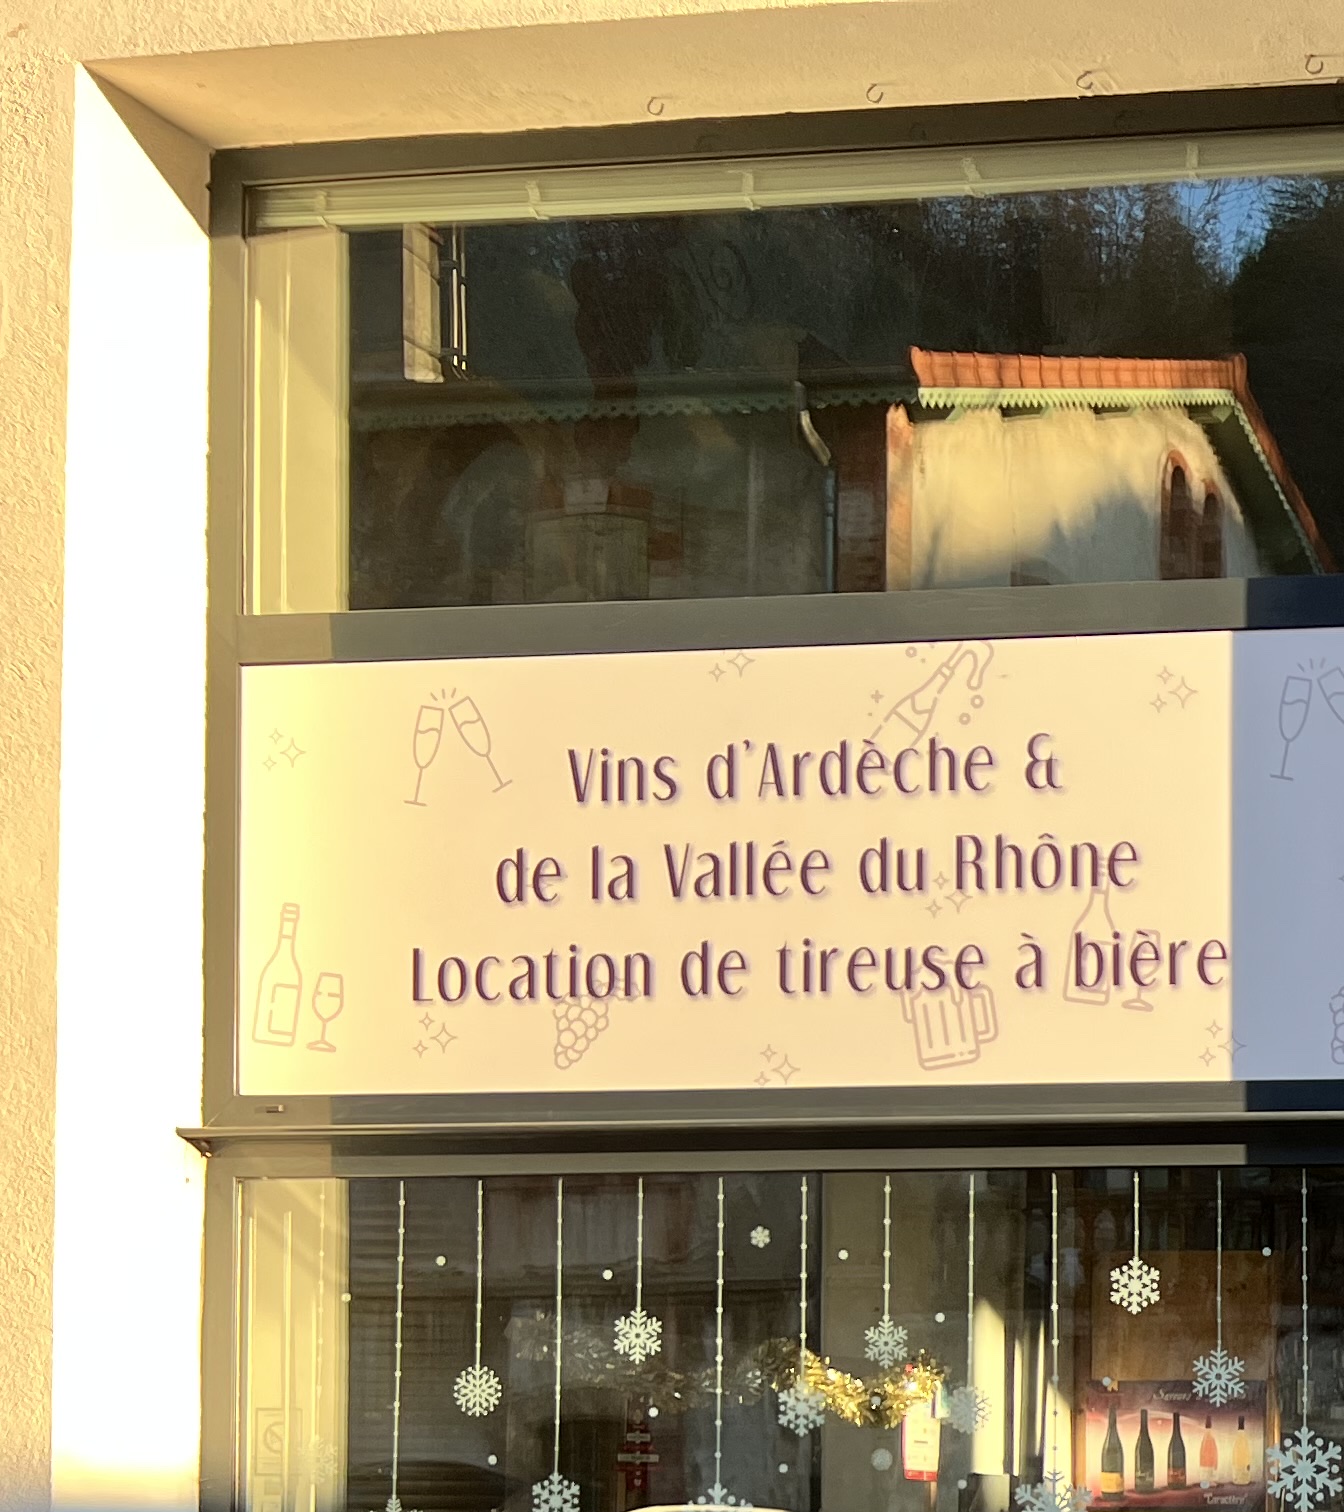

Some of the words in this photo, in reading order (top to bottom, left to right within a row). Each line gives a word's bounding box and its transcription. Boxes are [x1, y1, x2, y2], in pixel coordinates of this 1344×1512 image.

[567, 743, 679, 804] Vins
[706, 733, 996, 800] d'Ardèche
[1025, 733, 1064, 791] &
[495, 846, 564, 903] de
[590, 841, 636, 901] la
[664, 837, 831, 899] Vallée
[858, 837, 929, 893] du
[954, 831, 1140, 891] Rhône
[411, 938, 652, 1003] Location
[680, 938, 748, 998] de
[776, 934, 986, 995] tireuse
[1014, 931, 1045, 990] à
[1072, 929, 1231, 989] bière
